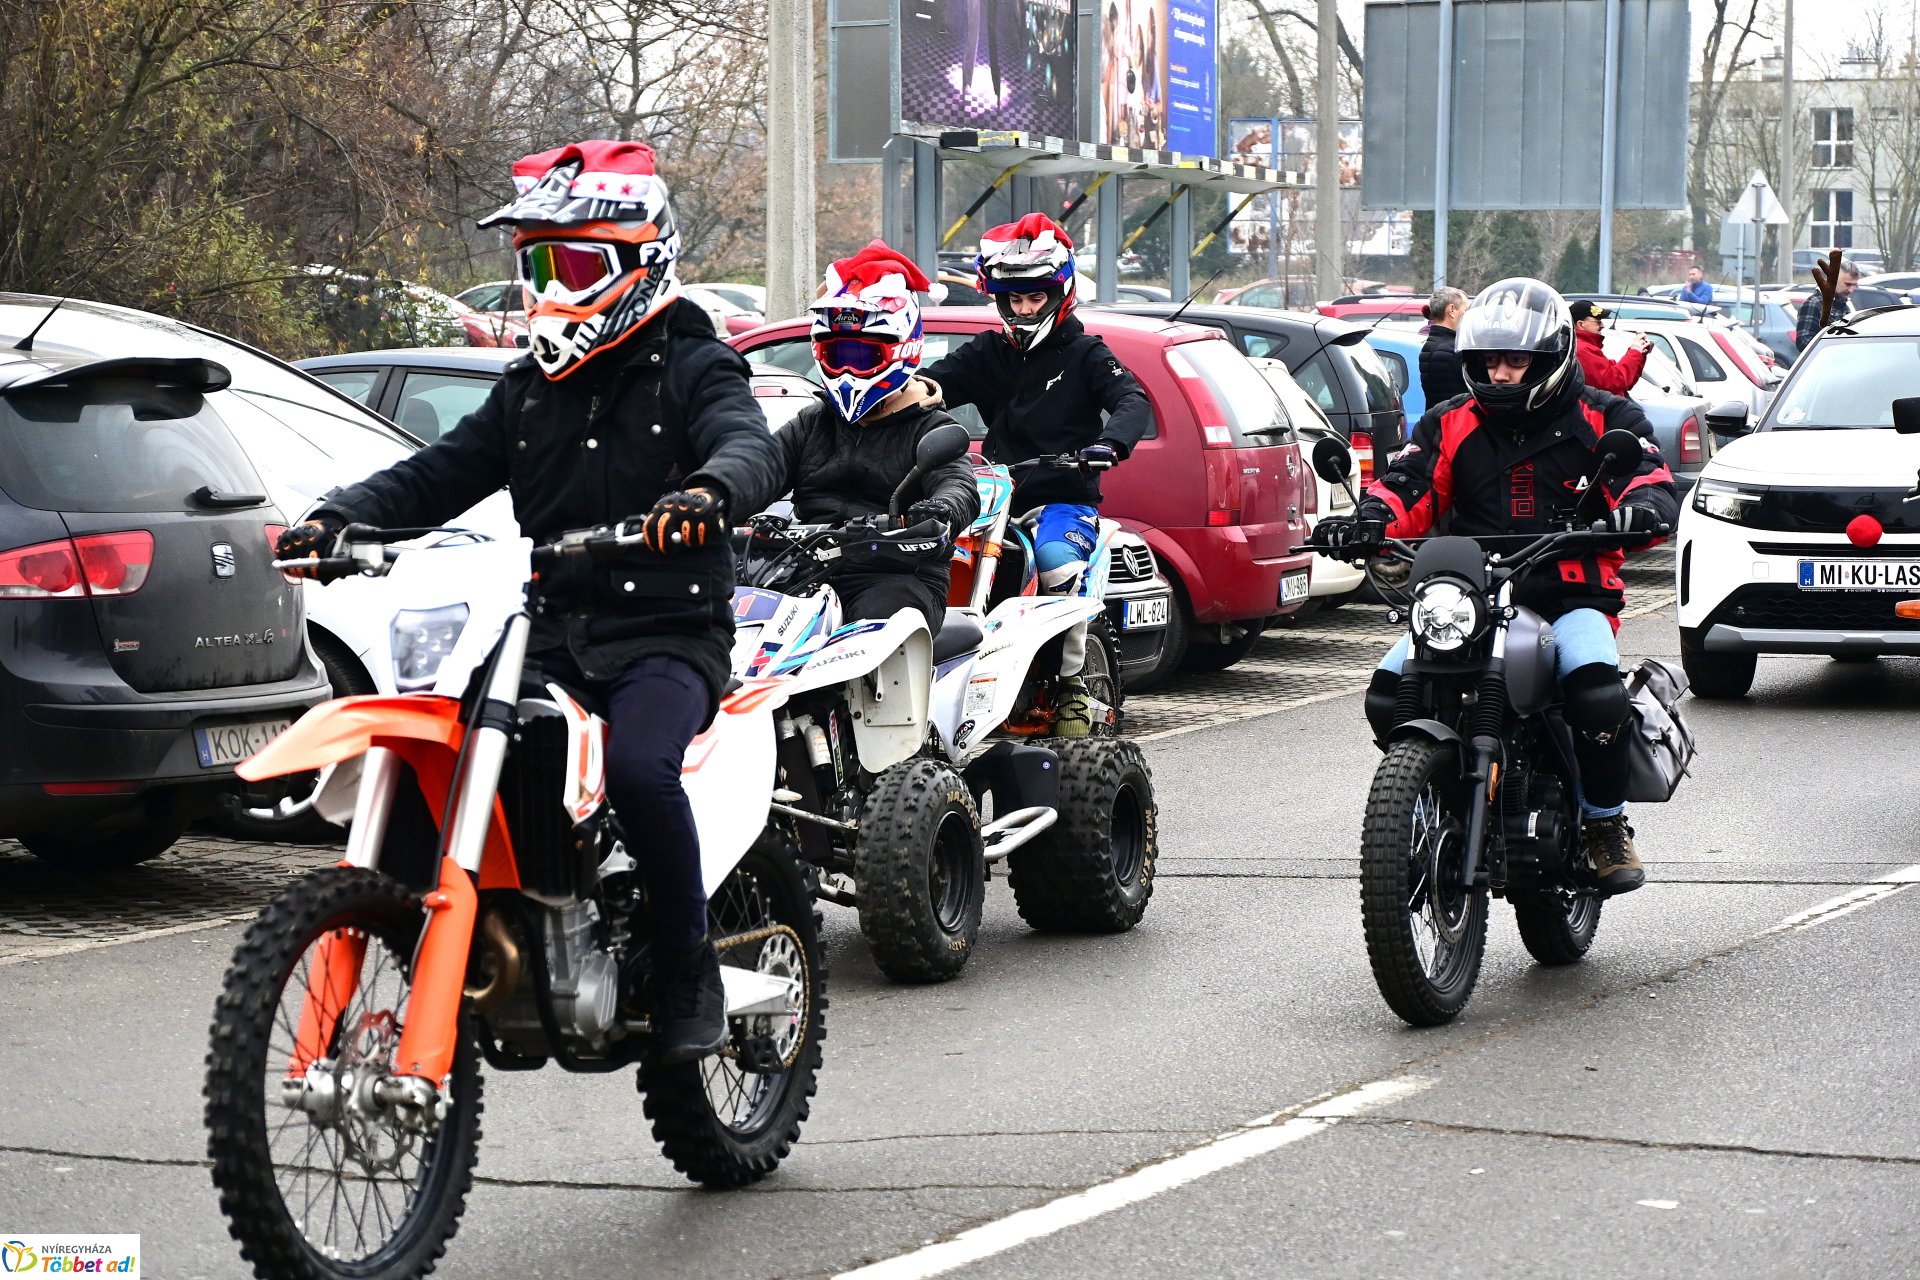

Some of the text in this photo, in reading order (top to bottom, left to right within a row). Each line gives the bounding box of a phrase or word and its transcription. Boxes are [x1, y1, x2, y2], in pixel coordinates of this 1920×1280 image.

[1820, 565, 1920, 586] MI KU-LAS
[777, 604, 799, 637] SUZUKI
[1129, 599, 1166, 625] LWL-824
[194, 634, 240, 648] ALTEA
[245, 633, 262, 645] XL
[806, 649, 866, 671] SUZUKI
[1139, 809, 1153, 887] MAXXIS
